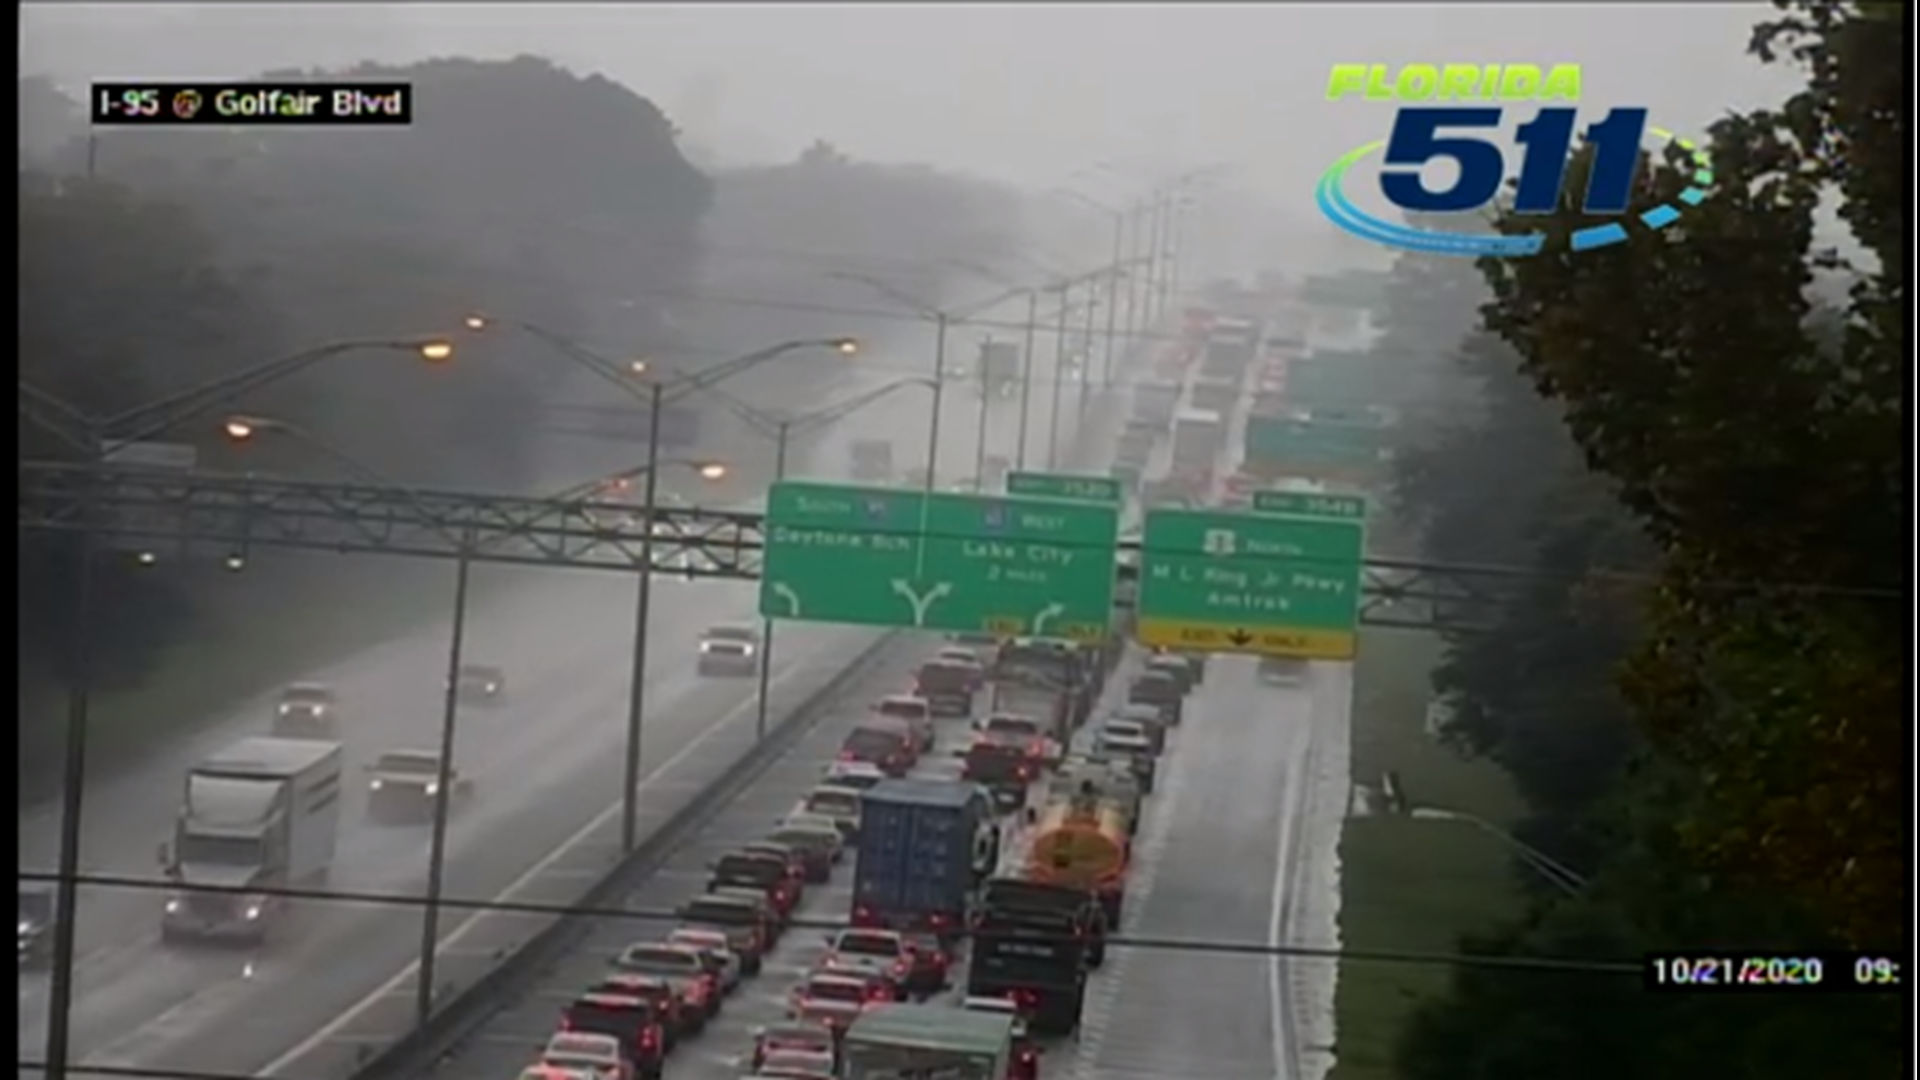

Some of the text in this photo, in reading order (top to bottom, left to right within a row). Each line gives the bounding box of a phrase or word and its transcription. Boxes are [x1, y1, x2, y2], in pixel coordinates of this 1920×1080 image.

[962, 539, 1074, 567] Lake City
[986, 564, 1001, 582] 2
[1152, 564, 1346, 595] M L King Jr Pkwy
[1206, 590, 1291, 611] Amtrak
